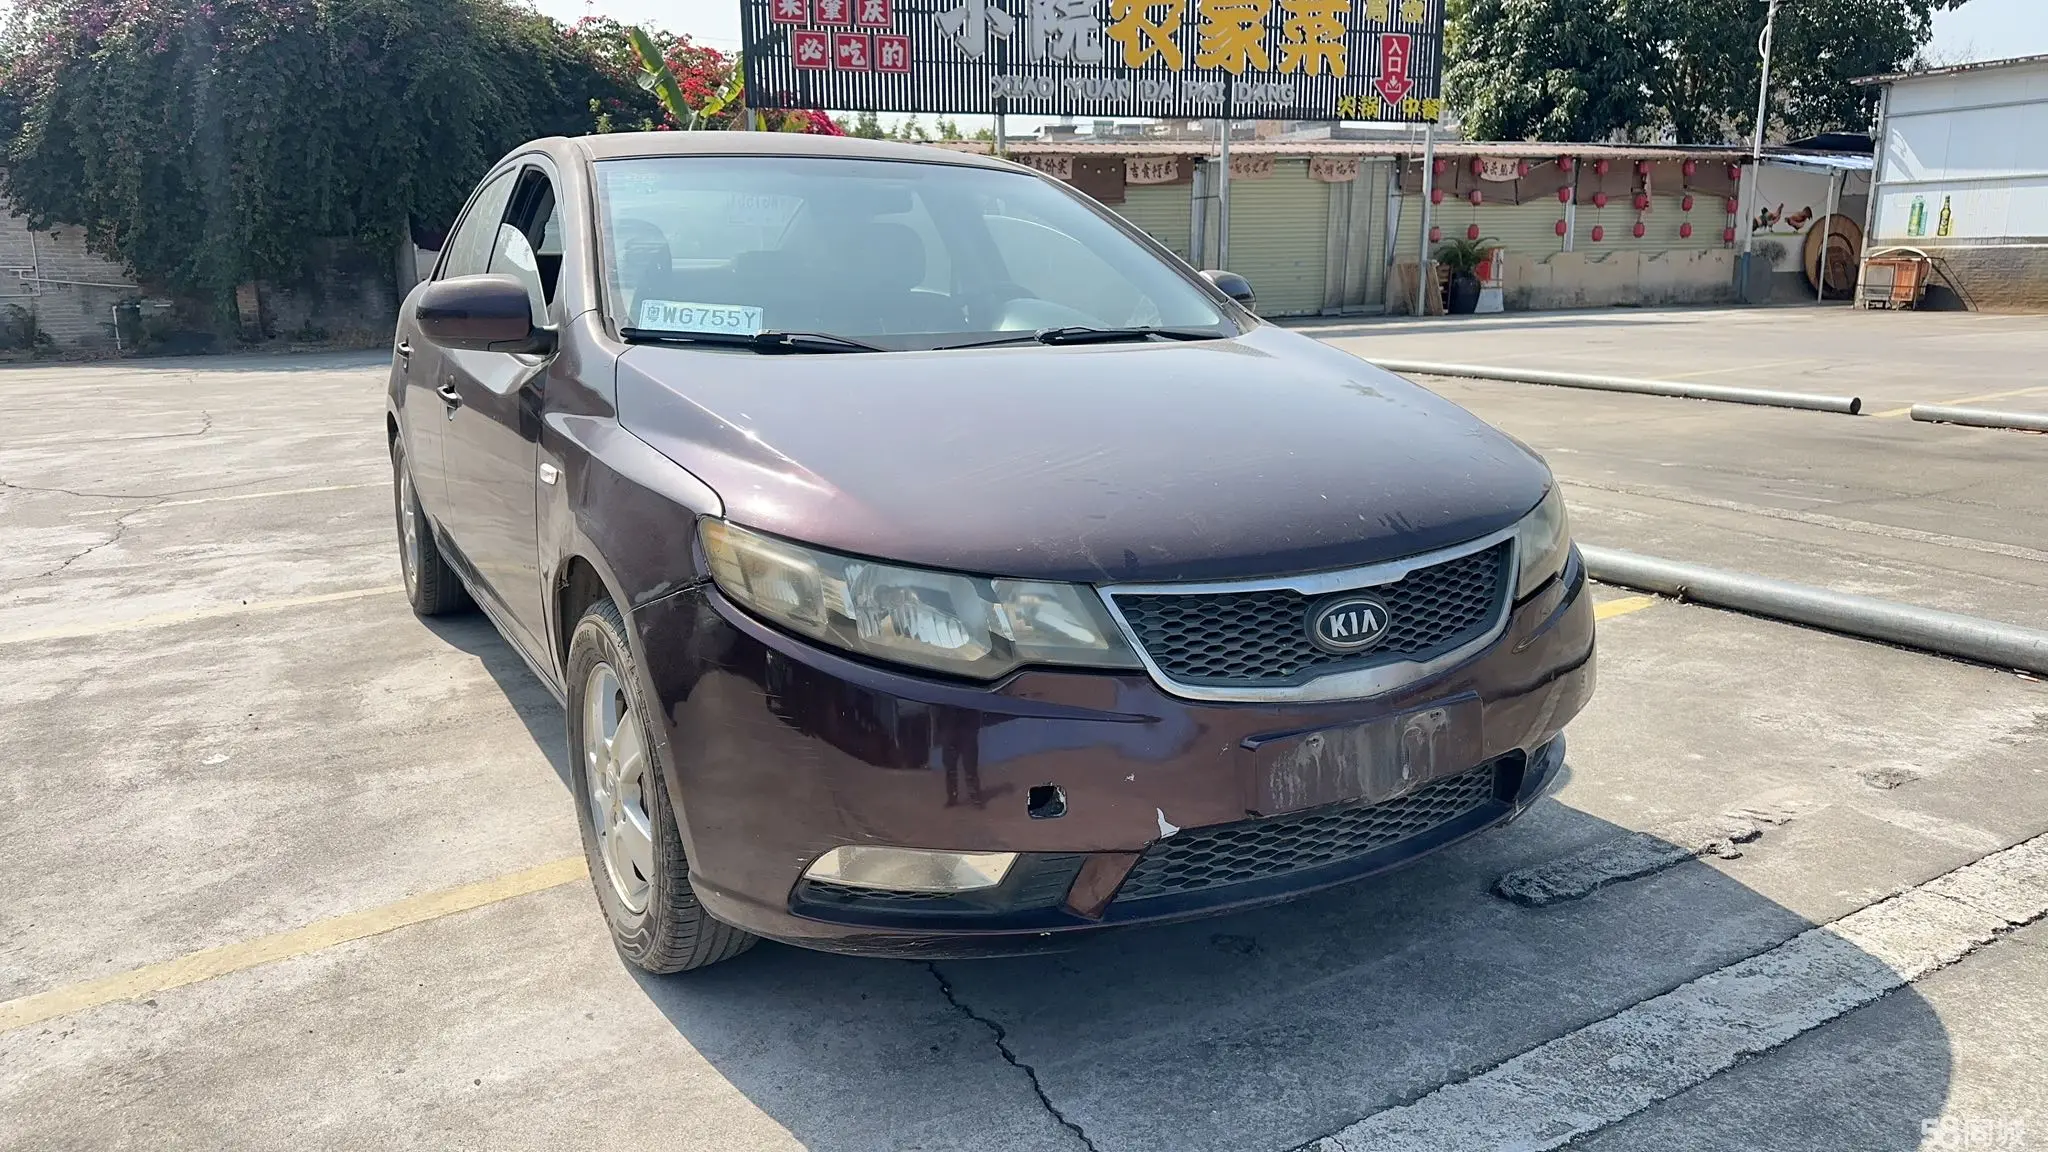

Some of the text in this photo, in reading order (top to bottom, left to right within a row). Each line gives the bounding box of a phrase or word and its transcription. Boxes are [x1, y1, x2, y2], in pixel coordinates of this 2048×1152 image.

[799, 38, 904, 68] 必吃的
[1388, 38, 1402, 73] 入口
[991, 75, 1295, 106] XIAO YUAN DA PAI DANG
[1336, 95, 1440, 120] 火锅 中餐
[648, 305, 756, 328] 粤WG755Y
[1330, 609, 1379, 638] KIA
